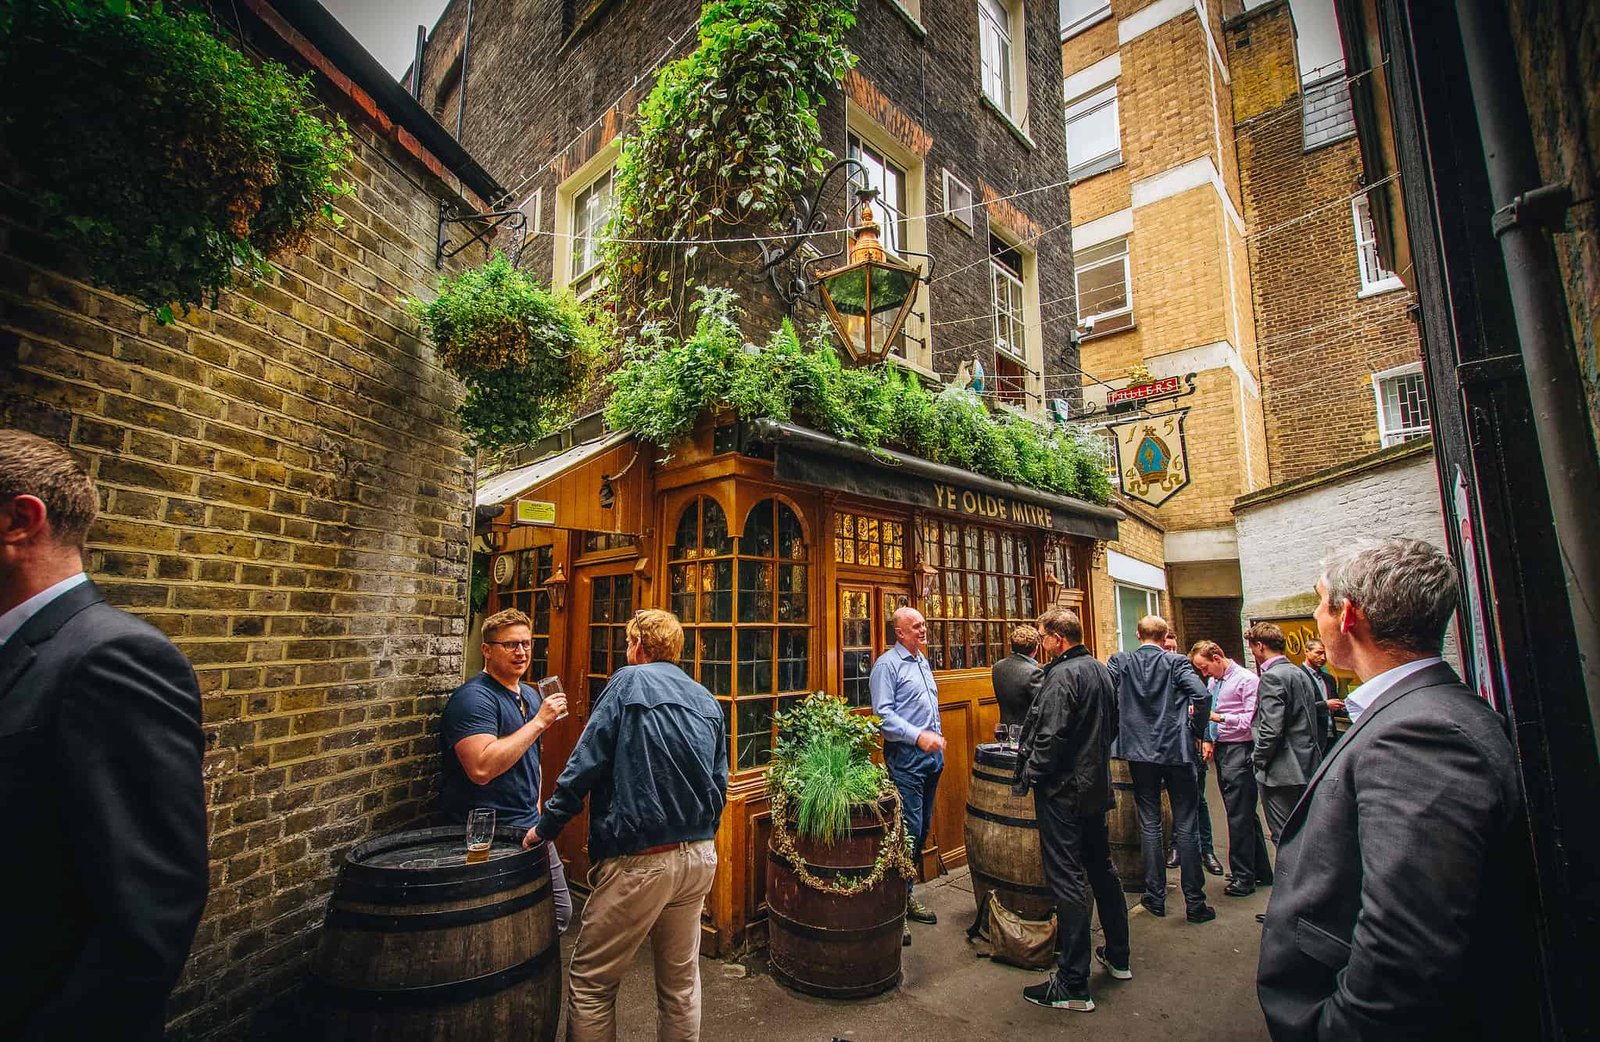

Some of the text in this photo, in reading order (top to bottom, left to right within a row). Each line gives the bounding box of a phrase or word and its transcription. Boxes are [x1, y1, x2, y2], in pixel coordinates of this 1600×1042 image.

[1111, 381, 1173, 403] FULLER'S
[1125, 416, 1174, 444] 1 5
[1125, 455, 1183, 480] 4 6
[933, 483, 1053, 528] YE OLDE MITRE
